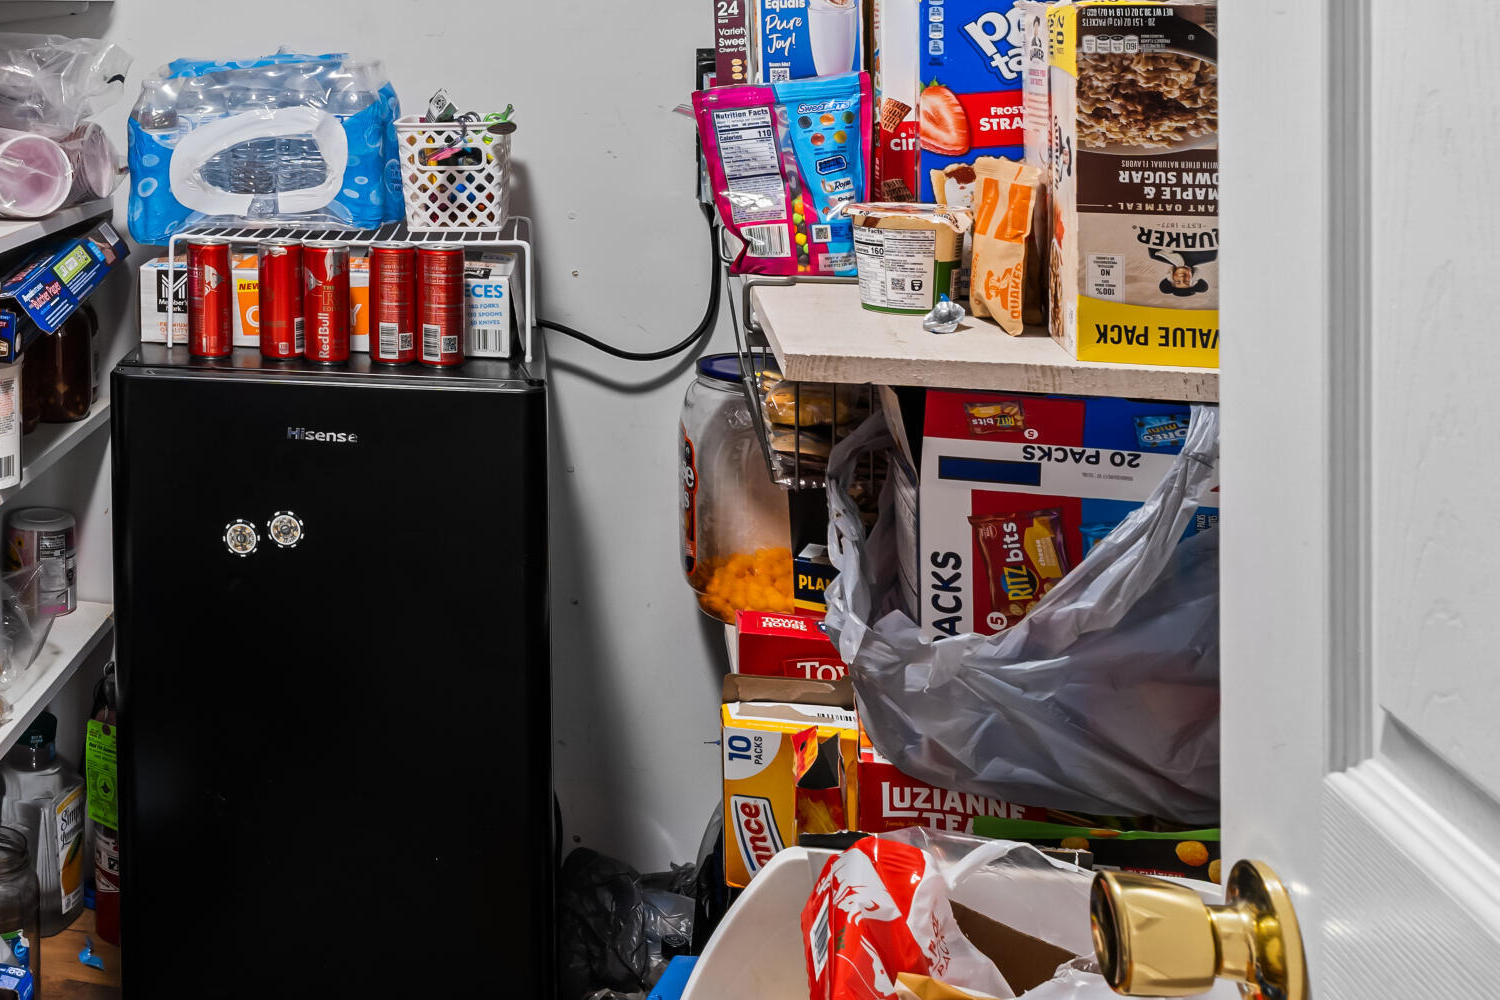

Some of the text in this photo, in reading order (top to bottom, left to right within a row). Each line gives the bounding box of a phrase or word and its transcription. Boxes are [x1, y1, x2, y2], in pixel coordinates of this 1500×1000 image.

[717, 1, 739, 16] 24
[765, 0, 805, 12] Equals
[765, 15, 802, 34] Pure
[767, 33, 796, 56] Joy!
[715, 108, 769, 120] Nutrition Facts
[757, 129, 772, 138] 110
[1121, 160, 1201, 169] OTHER NATURAL FLAVORS
[1118, 170, 1177, 184] SUGAR
[1144, 186, 1220, 200] MAPLE &
[1118, 202, 1182, 212] OATMEAL
[870, 247, 884, 255] 160
[1100, 268, 1110, 276] NO
[1010, 263, 1022, 320] QUAKER
[1094, 322, 1149, 345] PACK
[972, 415, 1015, 427] RITZ bits
[286, 427, 358, 443] Hisense
[1022, 445, 1142, 469] 20 PACKS
[1003, 522, 1033, 601] RITZ bits
[761, 617, 805, 627] TOWN
[762, 622, 807, 631] HOUSE
[728, 735, 752, 762] 10
[754, 736, 763, 765] PACKS
